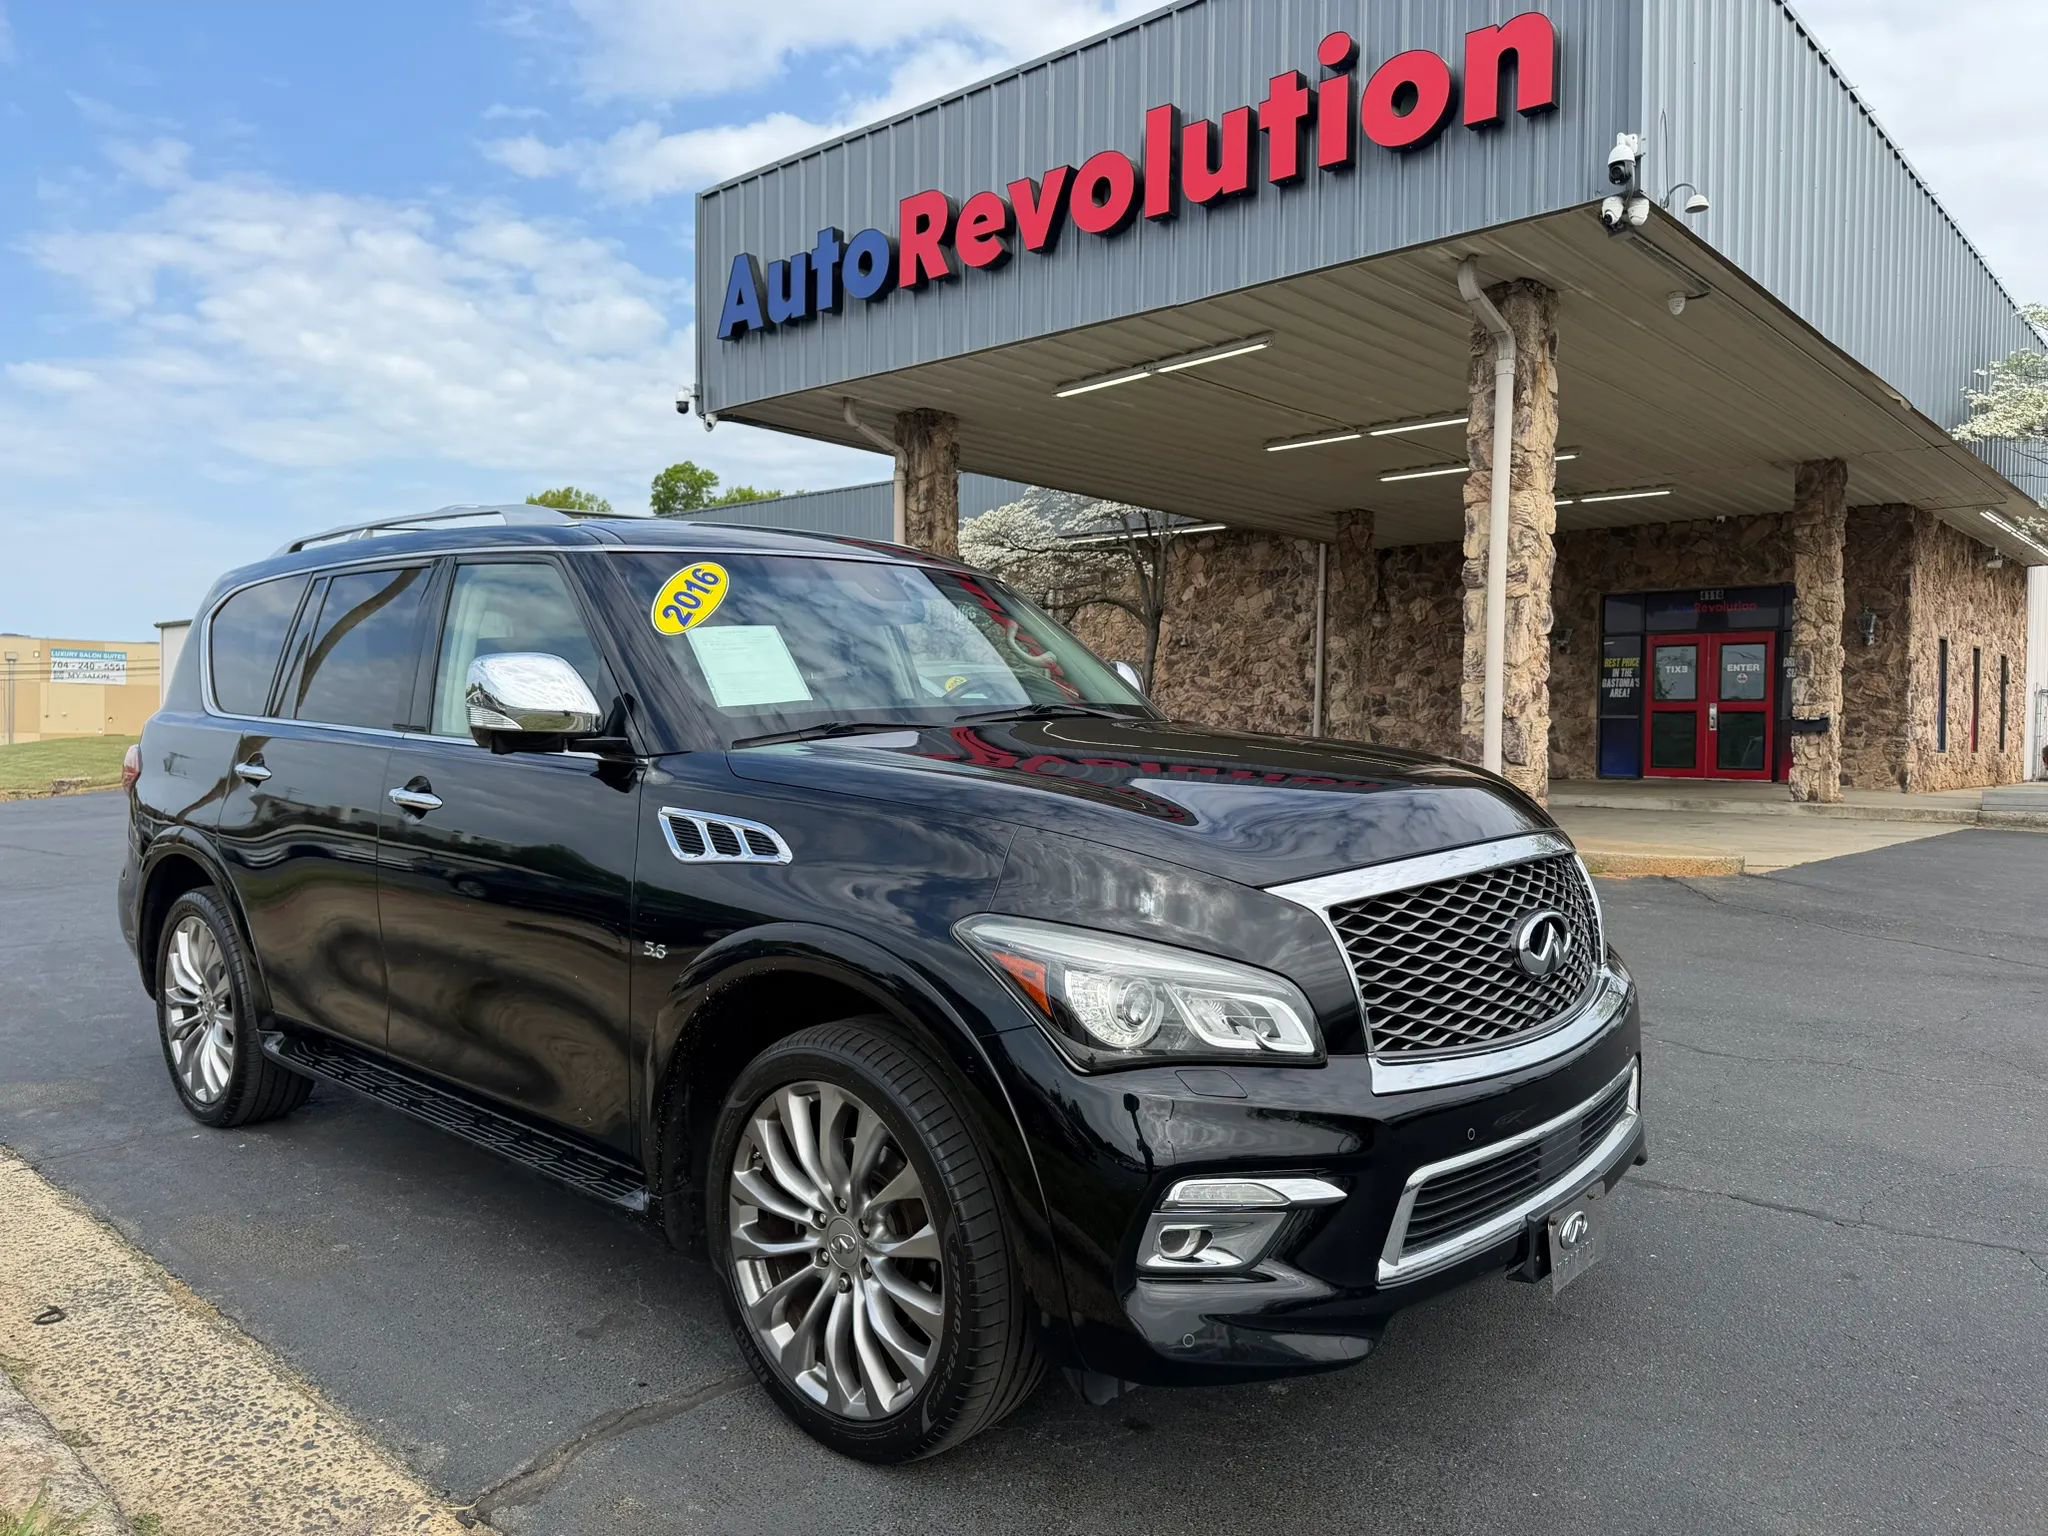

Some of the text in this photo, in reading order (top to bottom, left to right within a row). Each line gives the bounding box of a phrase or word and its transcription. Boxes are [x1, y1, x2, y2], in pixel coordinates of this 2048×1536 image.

[662, 568, 721, 627] 2016
[51, 650, 126, 661] LUXURY SALON SUITES
[52, 661, 69, 669] 704
[78, 662, 95, 670] 240
[1604, 657, 1640, 667] BEST PRICE
[1612, 668, 1633, 677] IN THE
[1727, 664, 1760, 672] ENTER
[1602, 678, 1640, 688] GASTONIA'S
[1609, 688, 1630, 698] AREA!
[643, 941, 667, 959] 5.6
